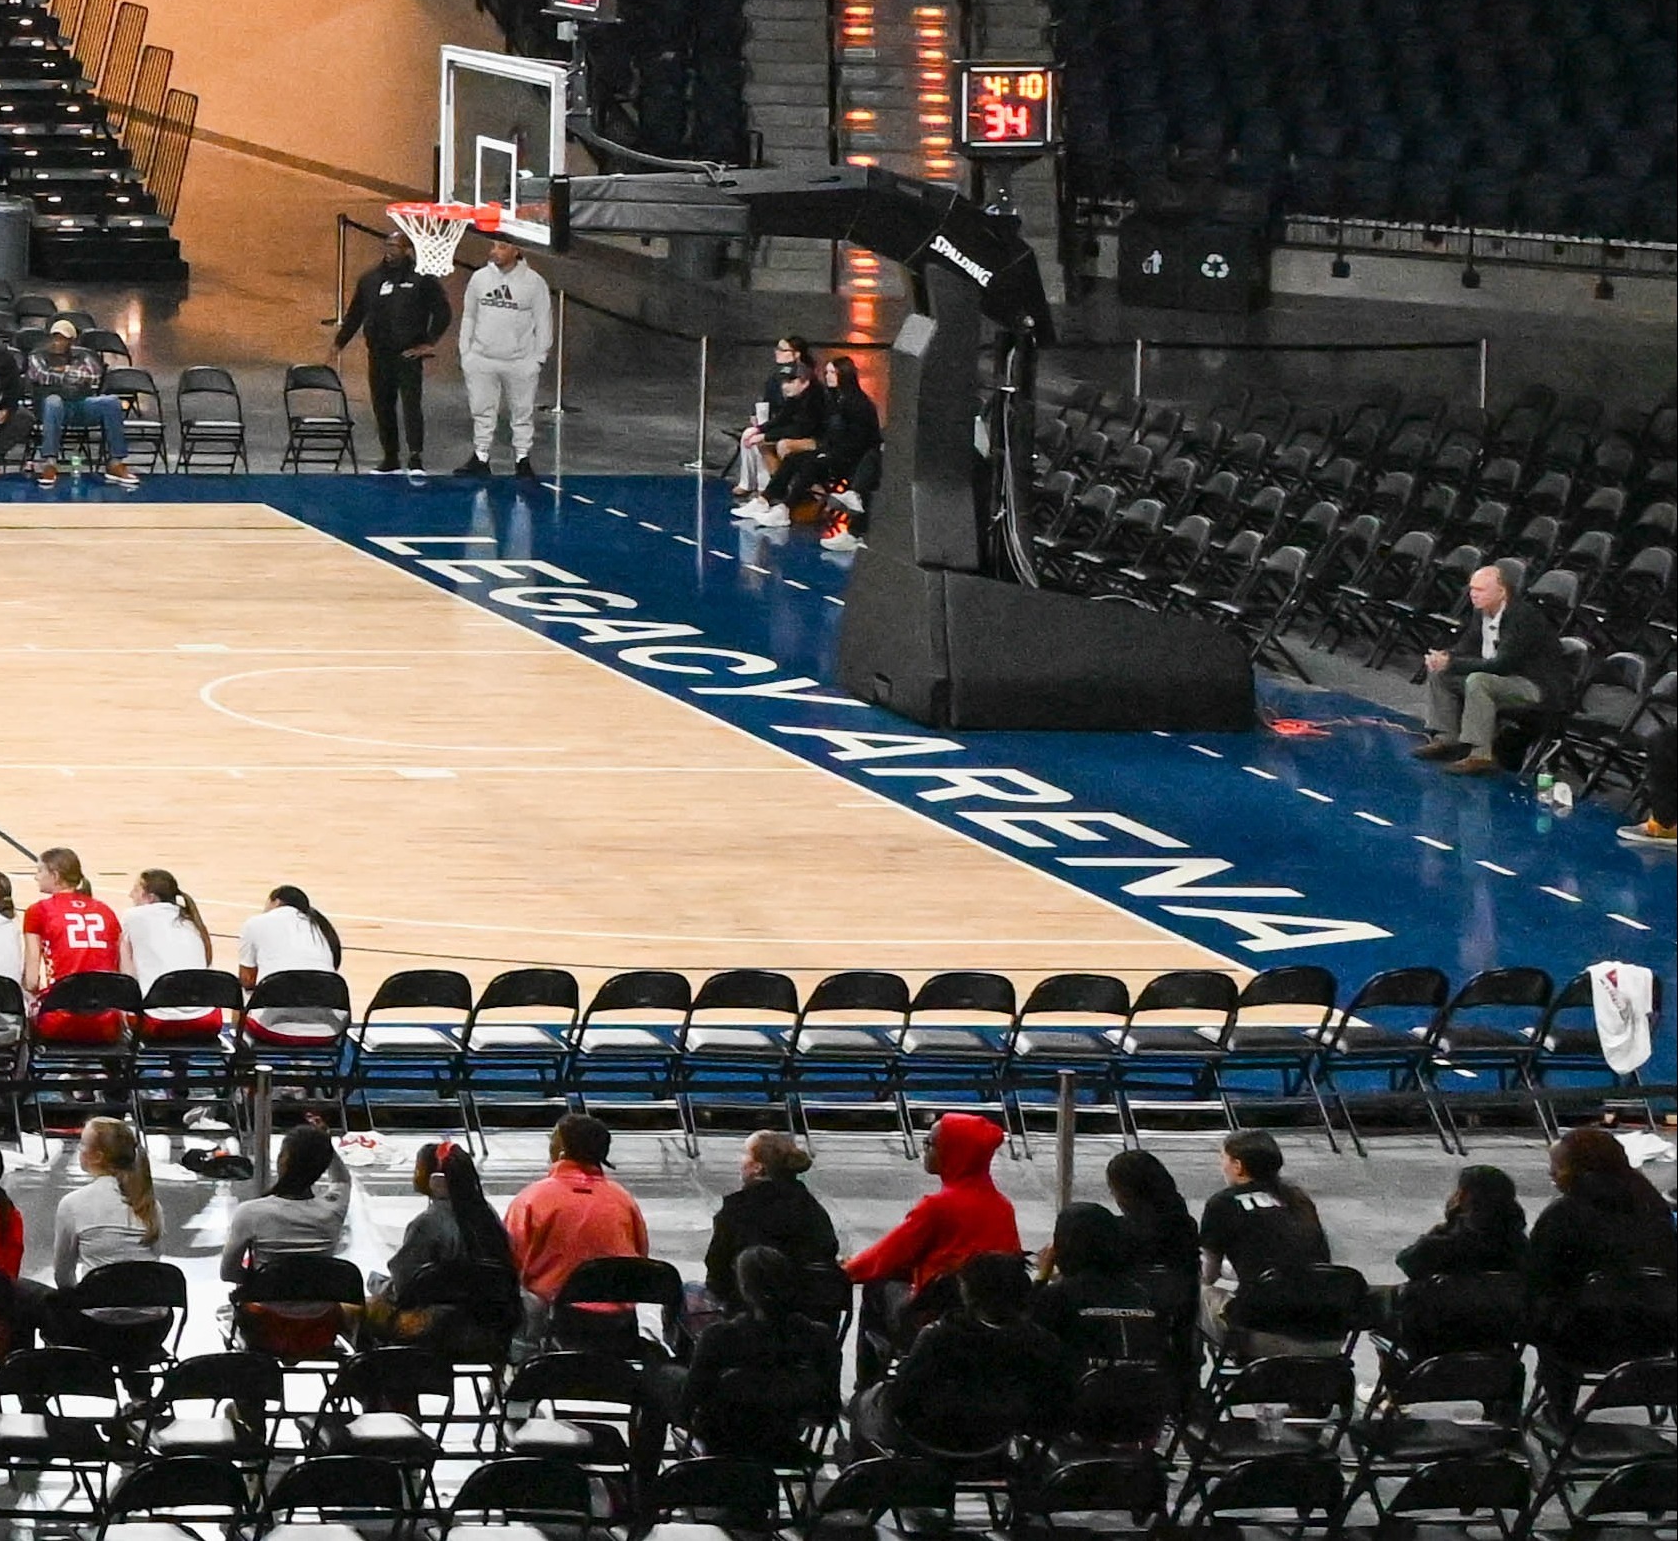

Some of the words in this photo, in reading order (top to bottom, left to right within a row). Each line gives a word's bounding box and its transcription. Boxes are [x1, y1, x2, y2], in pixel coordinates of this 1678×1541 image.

[982, 72, 1045, 100] 4:10
[984, 103, 1029, 140] 34
[929, 235, 994, 288] SPALDING
[479, 297, 519, 310] adidas
[364, 535, 872, 708] LEGACY
[768, 724, 1396, 952] ARENA
[65, 912, 108, 949] 22
